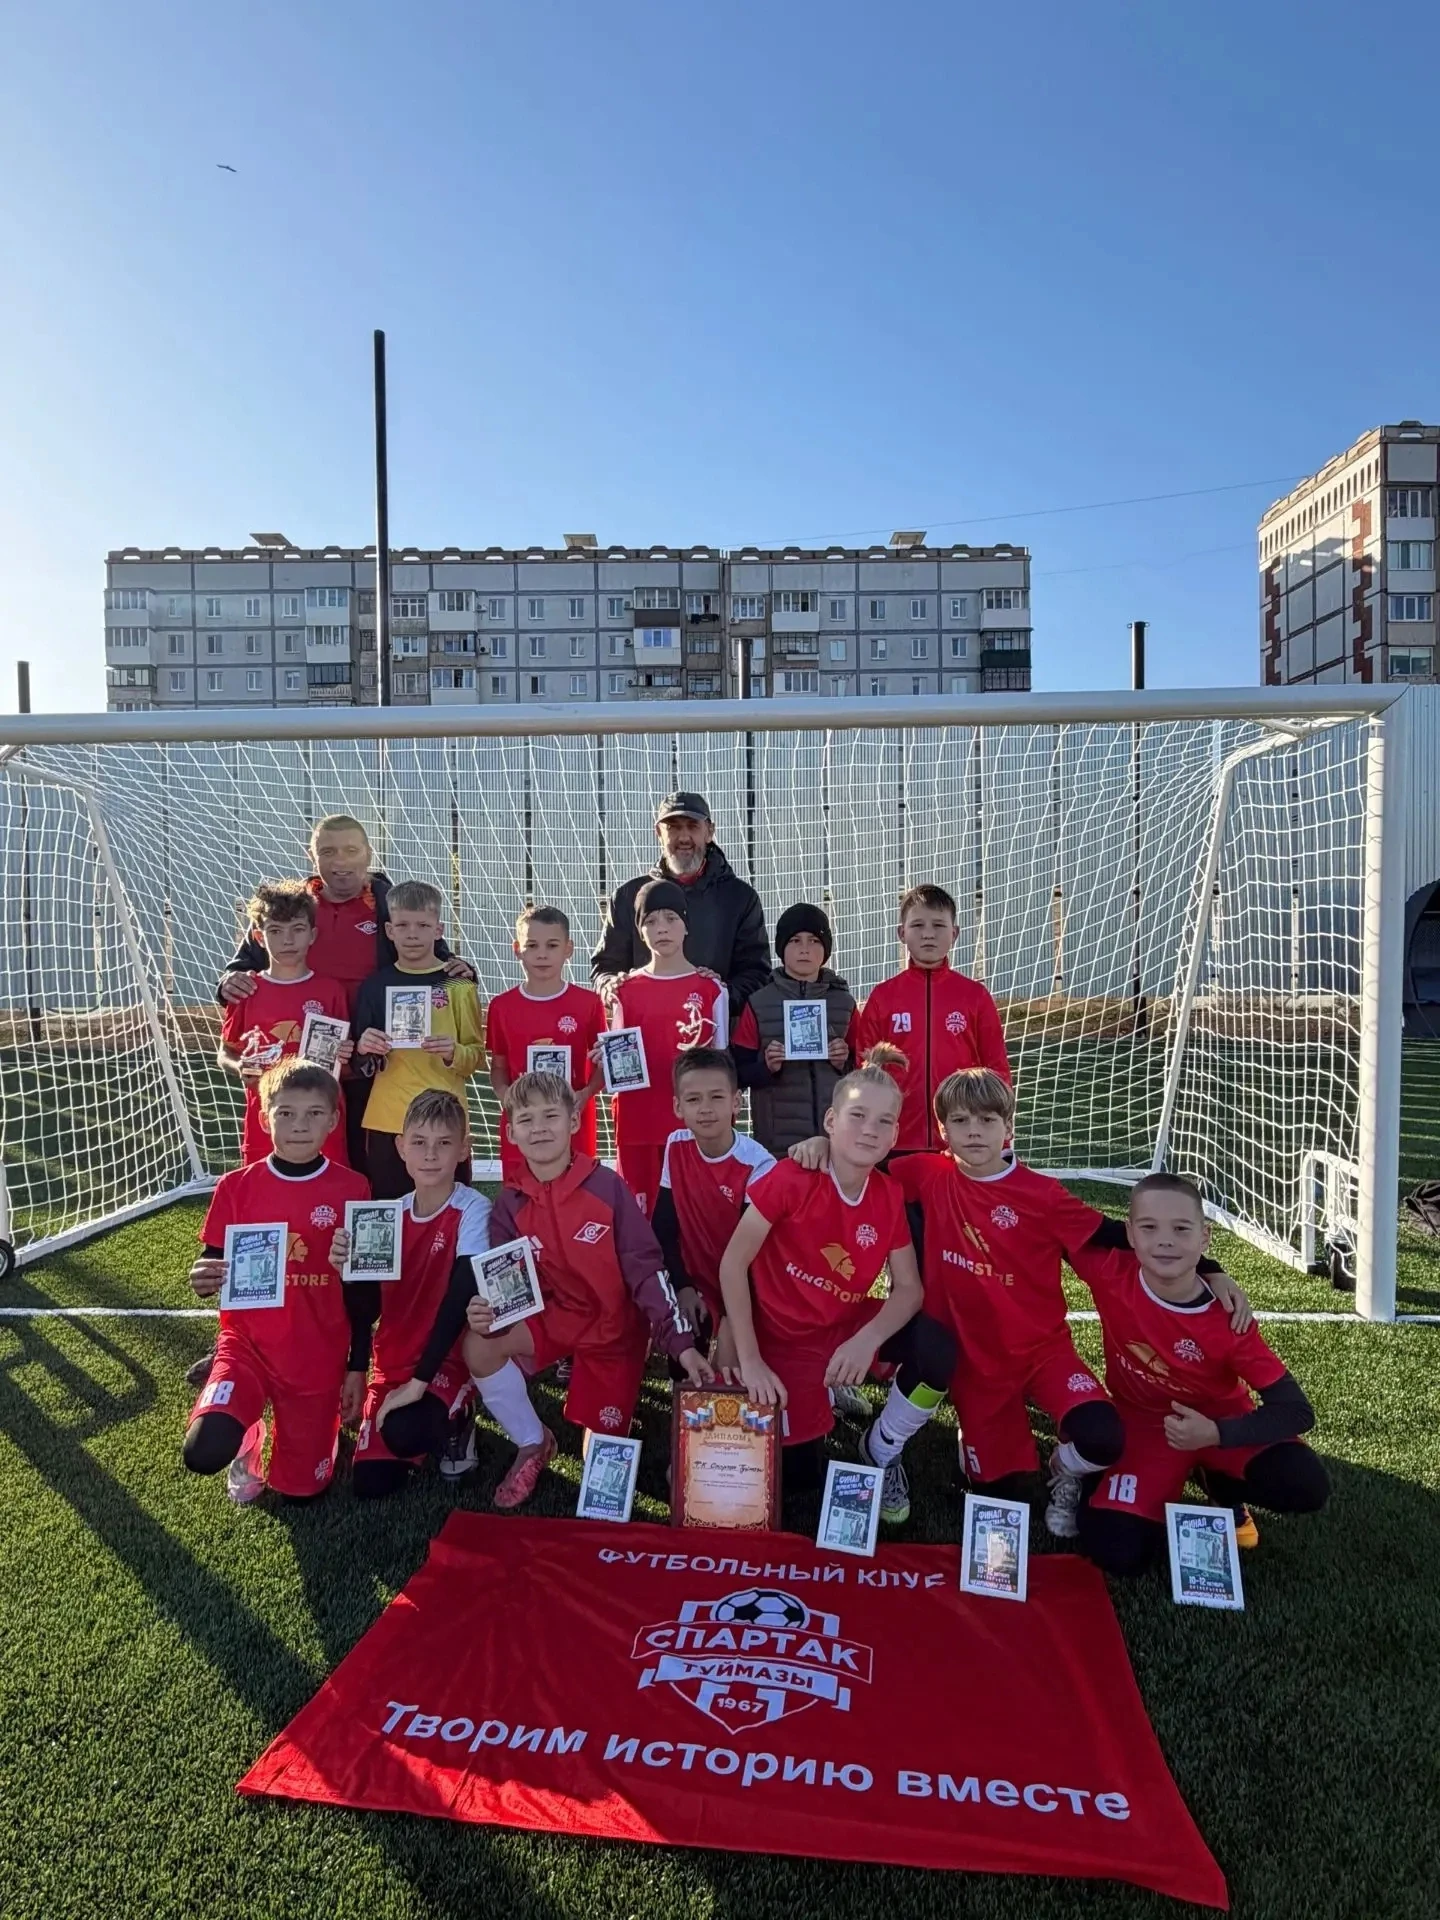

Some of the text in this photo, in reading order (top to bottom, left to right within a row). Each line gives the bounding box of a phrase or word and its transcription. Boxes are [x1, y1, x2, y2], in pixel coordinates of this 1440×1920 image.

[891, 1012, 911, 1033] 29
[942, 1249, 1014, 1286] KINGSTRE
[785, 1262, 865, 1303] KINGSTOR
[199, 1381, 235, 1409] 88
[1108, 1474, 1137, 1504] 18
[979, 1509, 1002, 1520] ФИНАЛ
[598, 1548, 845, 1584] ФУТБОЛЬНЫЙ
[977, 1565, 994, 1576] 10-12
[1189, 1576, 1206, 1585] 10-12
[645, 1626, 860, 1672] СПАРТАК
[683, 1661, 814, 1689] ТУЙМАЗЫ
[717, 1697, 764, 1713] 1967
[380, 1701, 1131, 1821] Творим историю вместе
